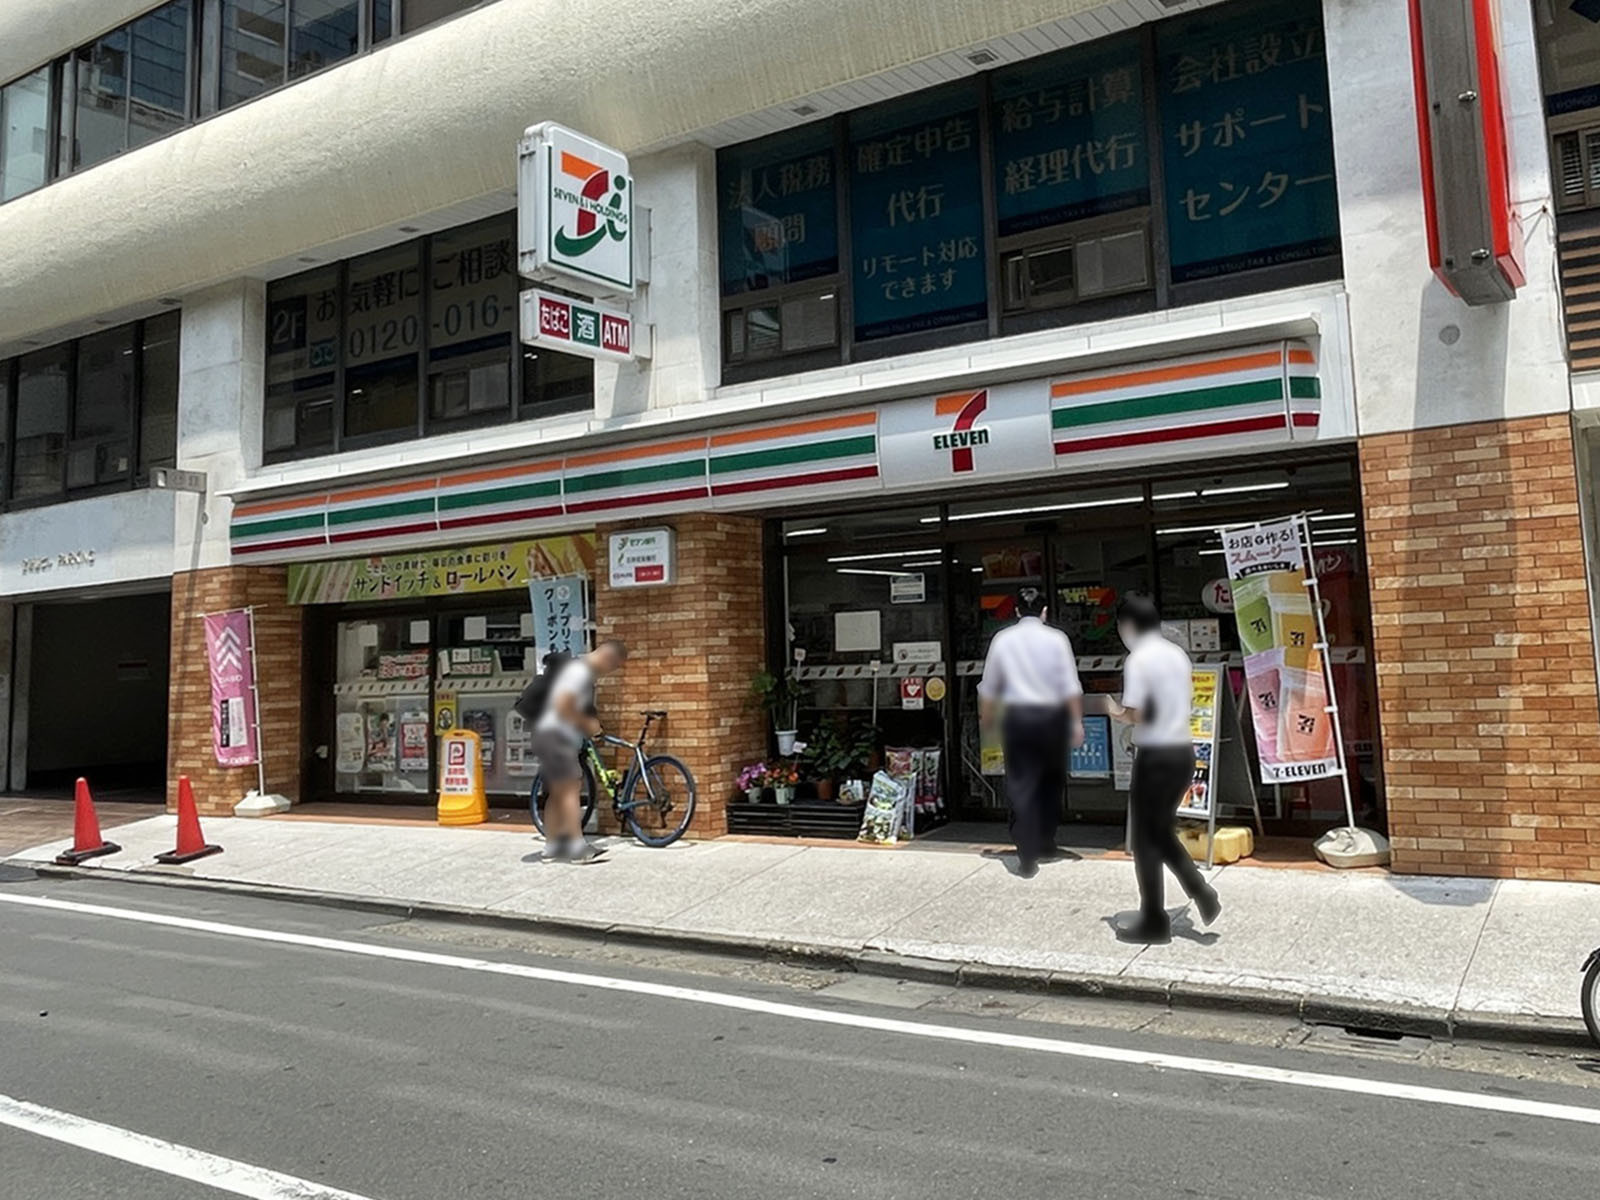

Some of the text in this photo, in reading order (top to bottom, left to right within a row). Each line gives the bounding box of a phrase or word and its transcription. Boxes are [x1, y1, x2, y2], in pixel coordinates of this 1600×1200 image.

[1003, 67, 1135, 132] 給与計算
[857, 118, 971, 174] 確定申告
[1177, 94, 1325, 158] サポート
[728, 155, 832, 209] 法人税務
[1003, 133, 1141, 195] 経理代行
[887, 183, 945, 227] 代行
[1178, 170, 1333, 222] センター
[862, 236, 978, 279] リモート対応
[881, 268, 958, 300] できます
[272, 308, 303, 345] 2F
[541, 302, 628, 348] たばこ 酒 ATM
[933, 428, 989, 450] ELEVEN
[1231, 544, 1297, 565] スムージー
